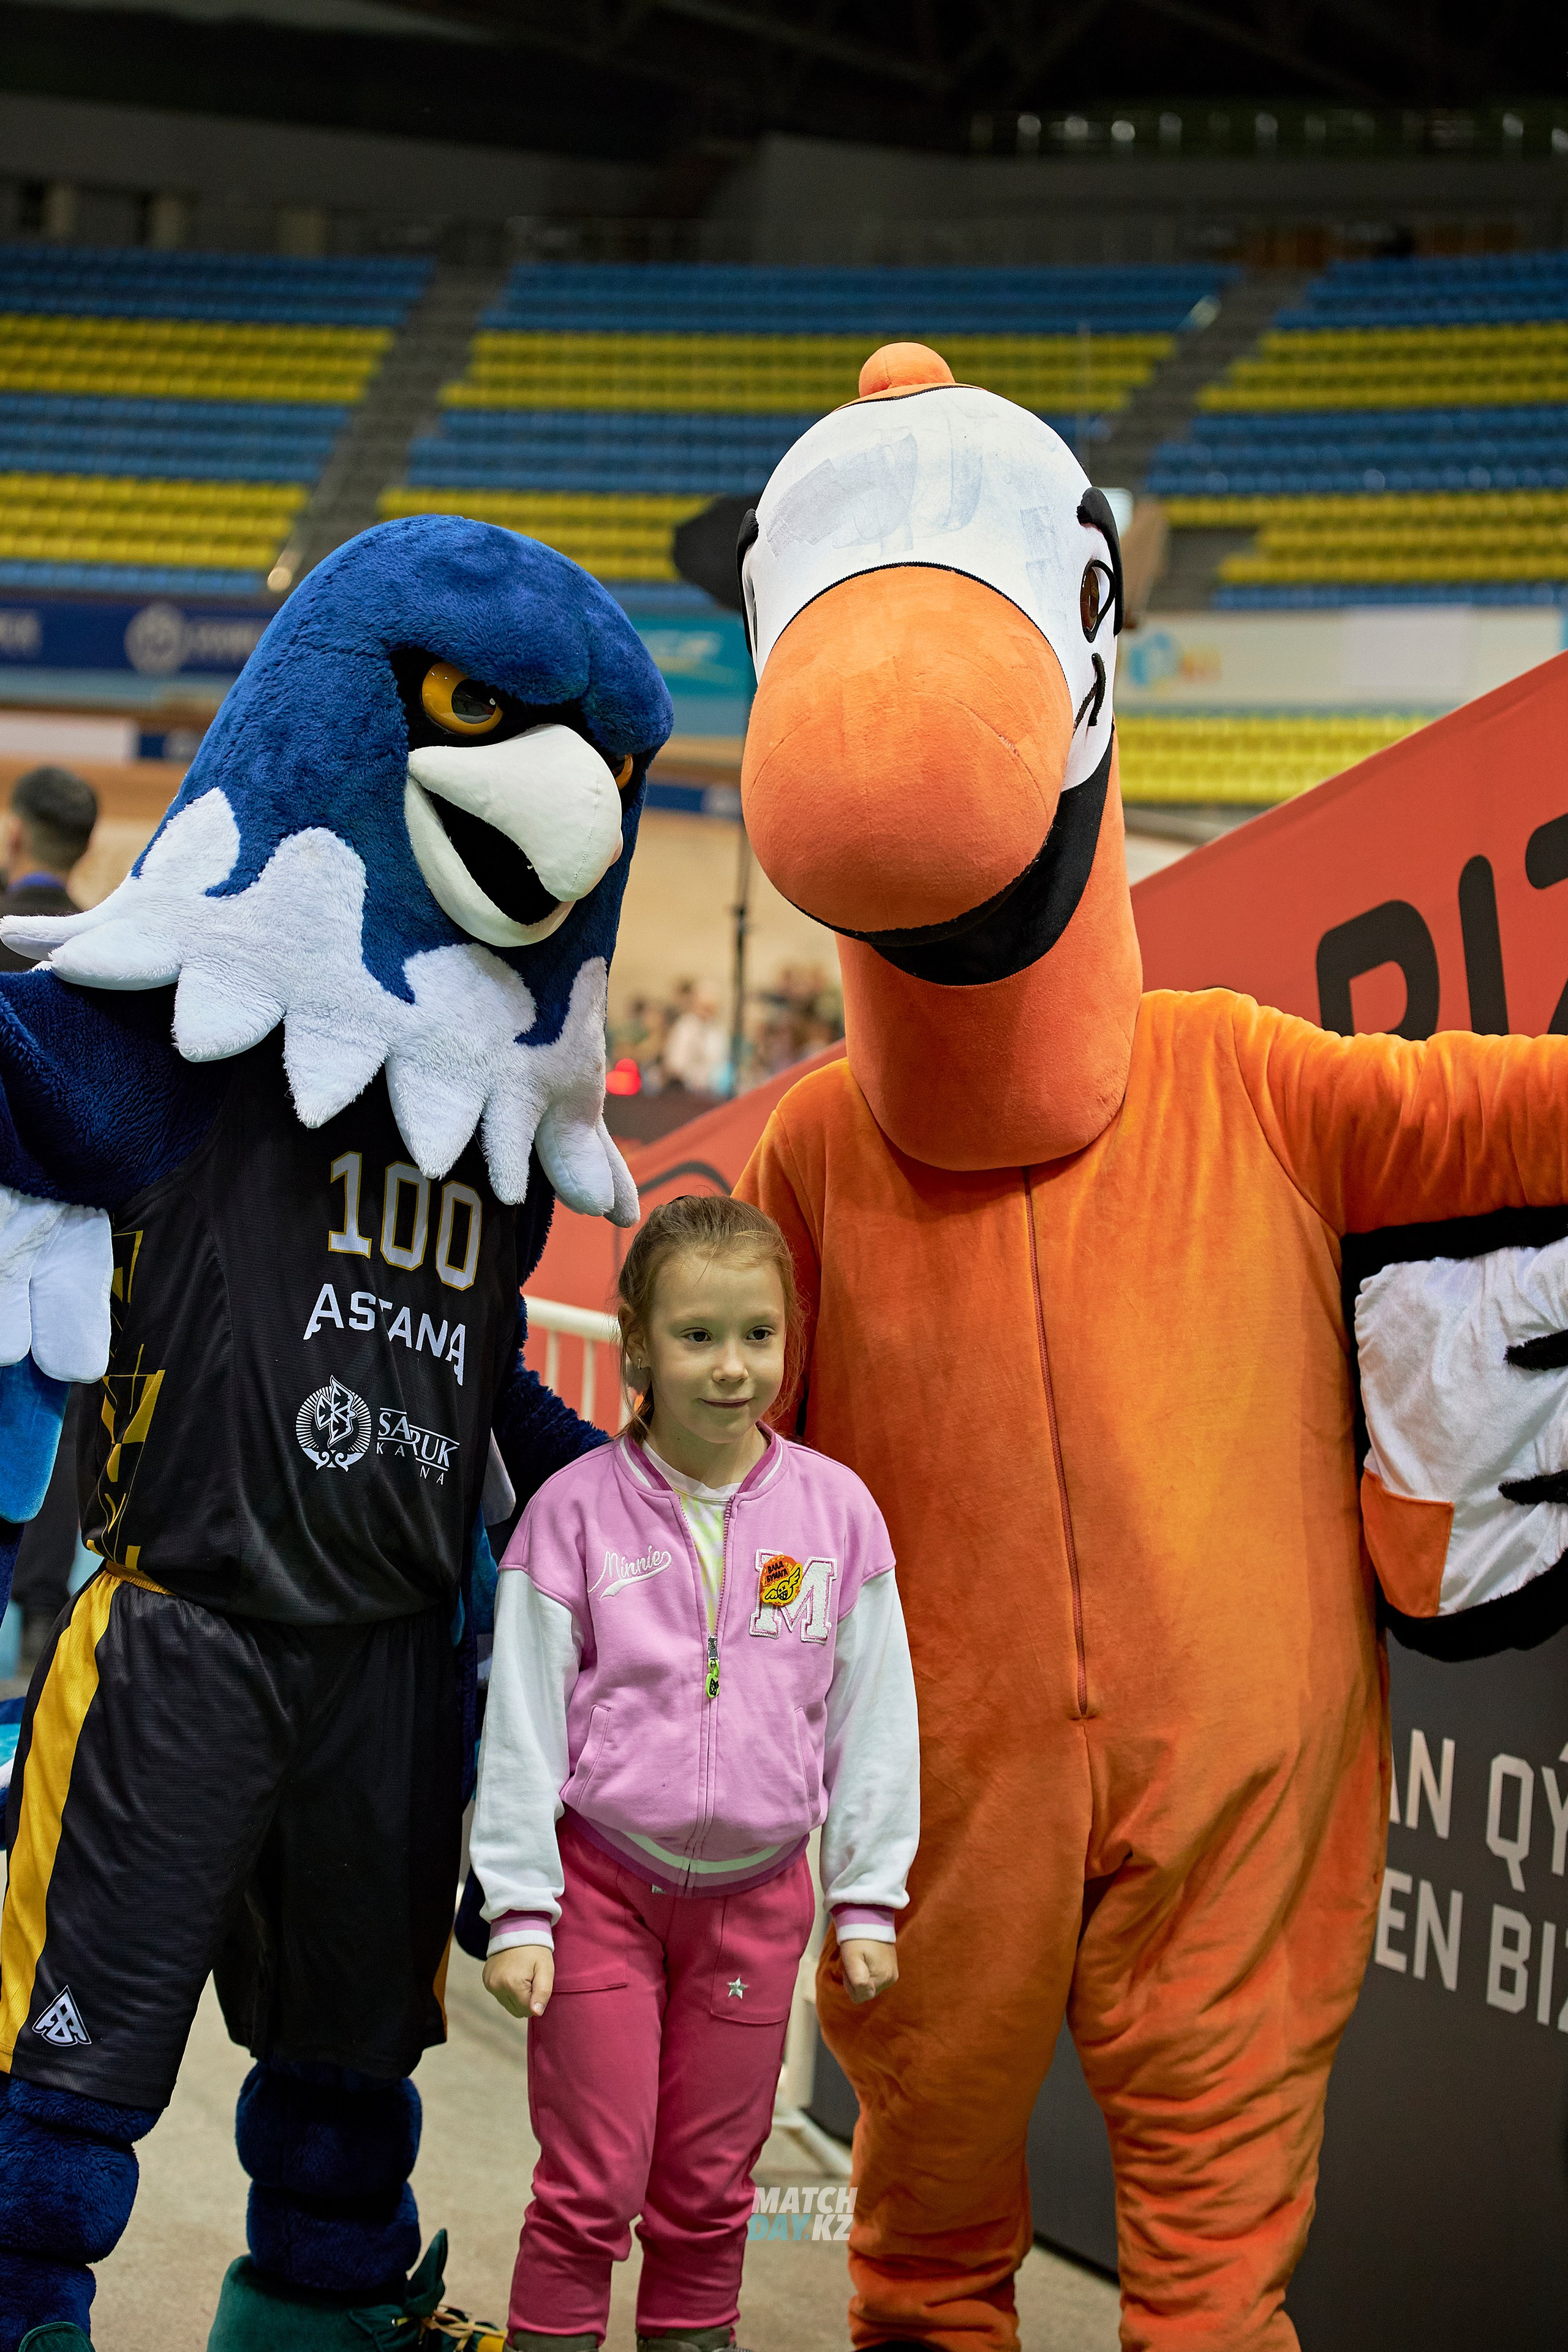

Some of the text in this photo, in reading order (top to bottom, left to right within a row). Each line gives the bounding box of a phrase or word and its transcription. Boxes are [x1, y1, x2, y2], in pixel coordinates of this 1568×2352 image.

[328, 1151, 482, 1291] 100
[587, 1545, 672, 1599] Minnie
[749, 1548, 837, 1645] M
[767, 1561, 784, 1574] ВЛАД
[1389, 1728, 1455, 1839] N
